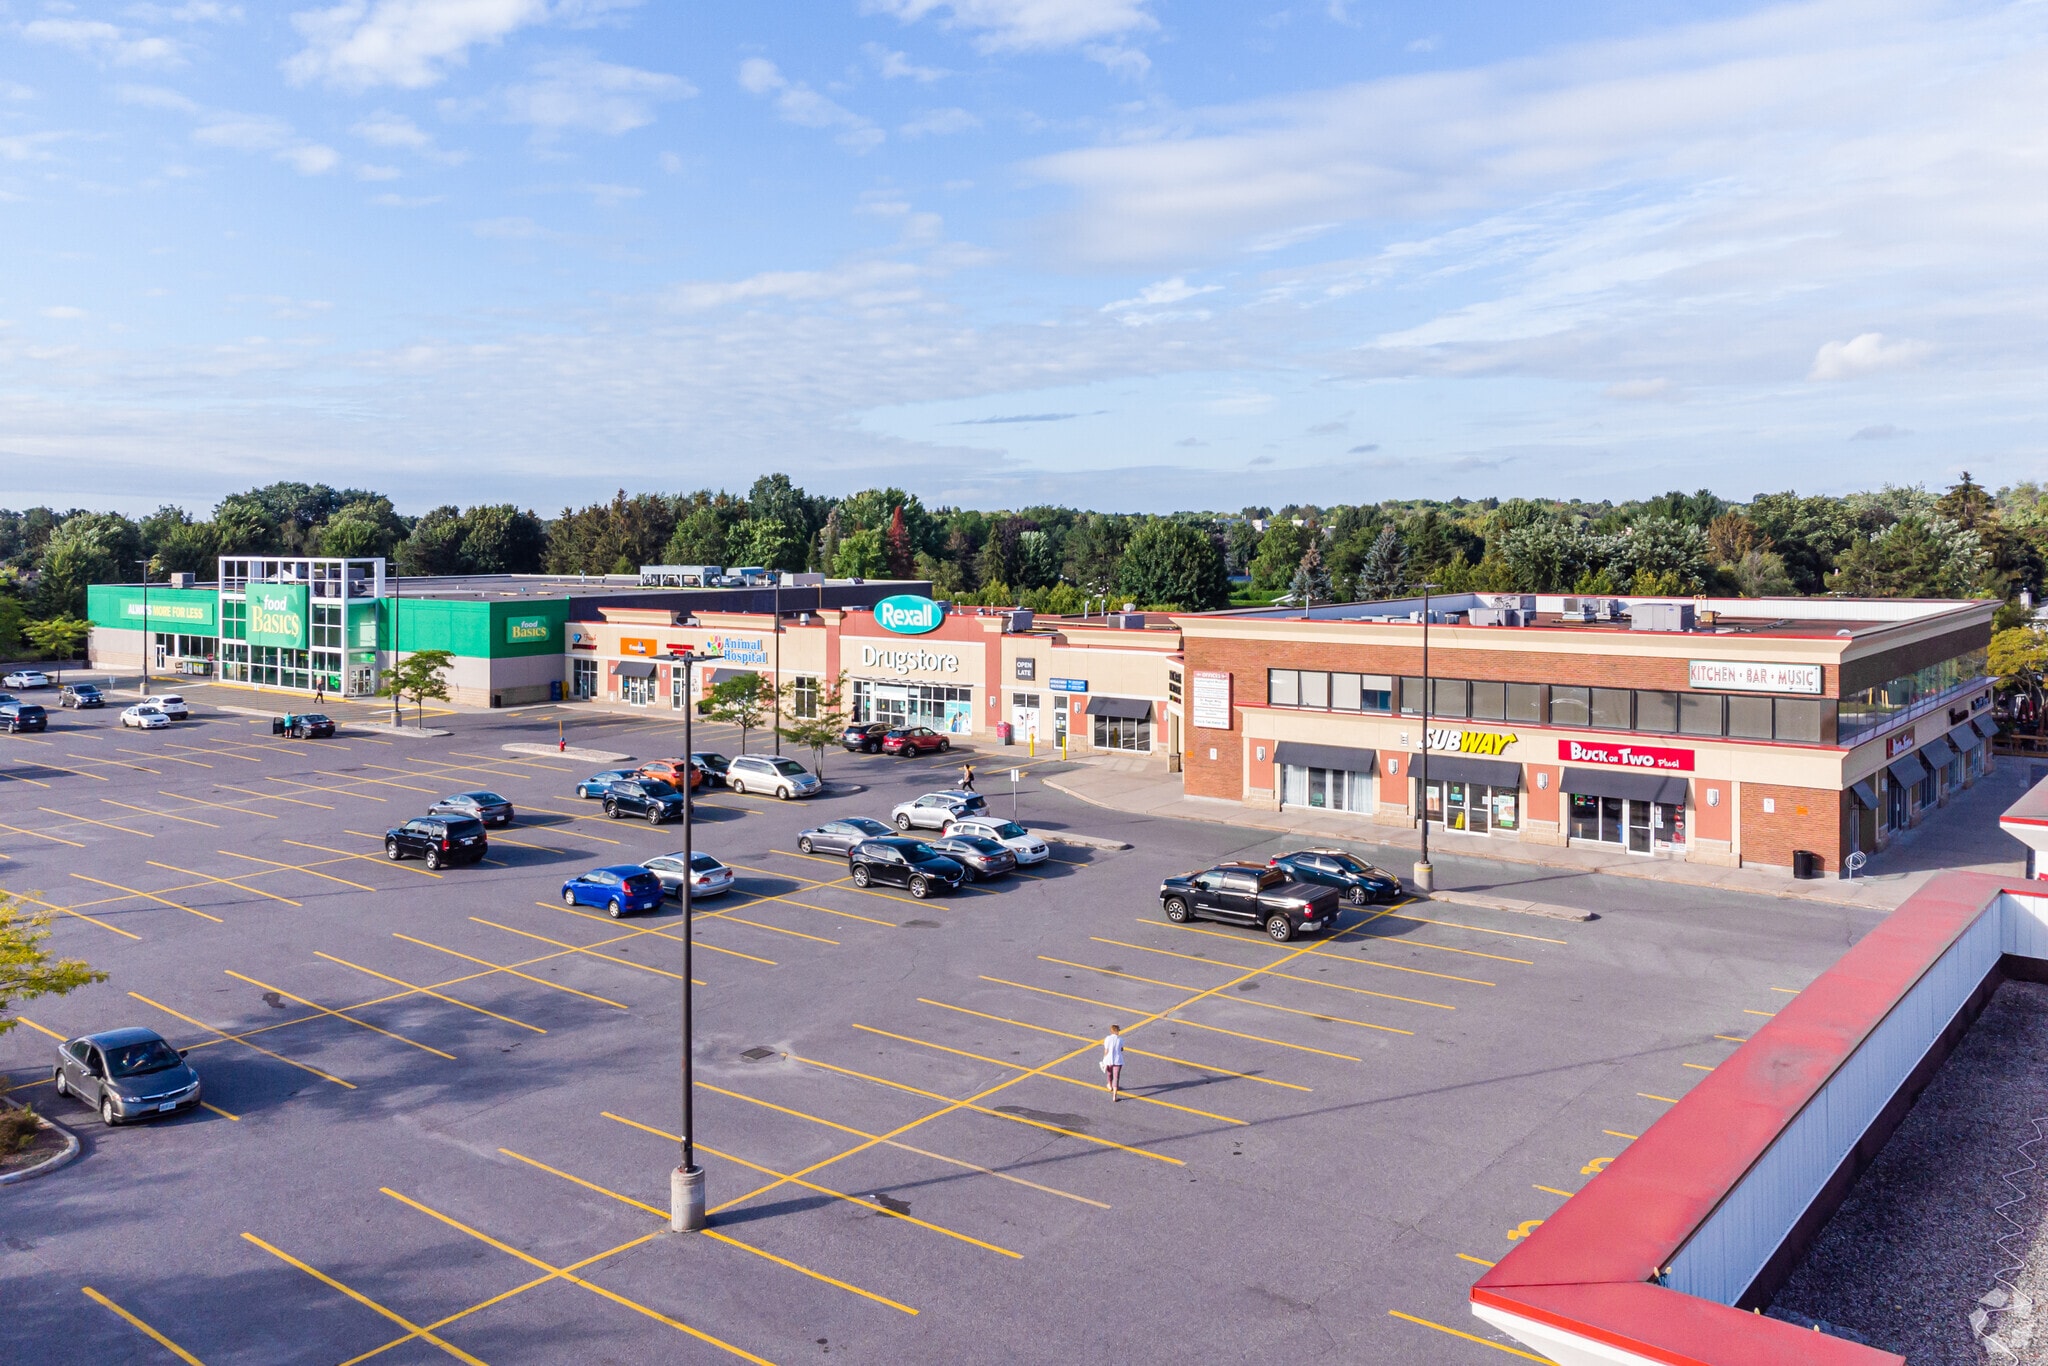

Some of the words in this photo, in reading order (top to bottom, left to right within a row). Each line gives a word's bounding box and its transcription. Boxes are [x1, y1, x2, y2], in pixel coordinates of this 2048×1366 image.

[263, 594, 287, 611] food
[128, 604, 152, 616] ALWAS
[152, 605, 171, 617] MORE
[172, 606, 185, 618] FOR
[186, 607, 204, 619] LESS
[882, 603, 933, 628] Rexall
[520, 620, 538, 628] food
[724, 637, 761, 651] Animal
[723, 650, 767, 664] Hospital
[862, 645, 958, 675] Drugstore
[1690, 665, 1736, 682] KITCHEN
[1746, 668, 1767, 684] BAR
[1778, 670, 1814, 686] MUSIC
[1415, 728, 1518, 756] SUBWAY
